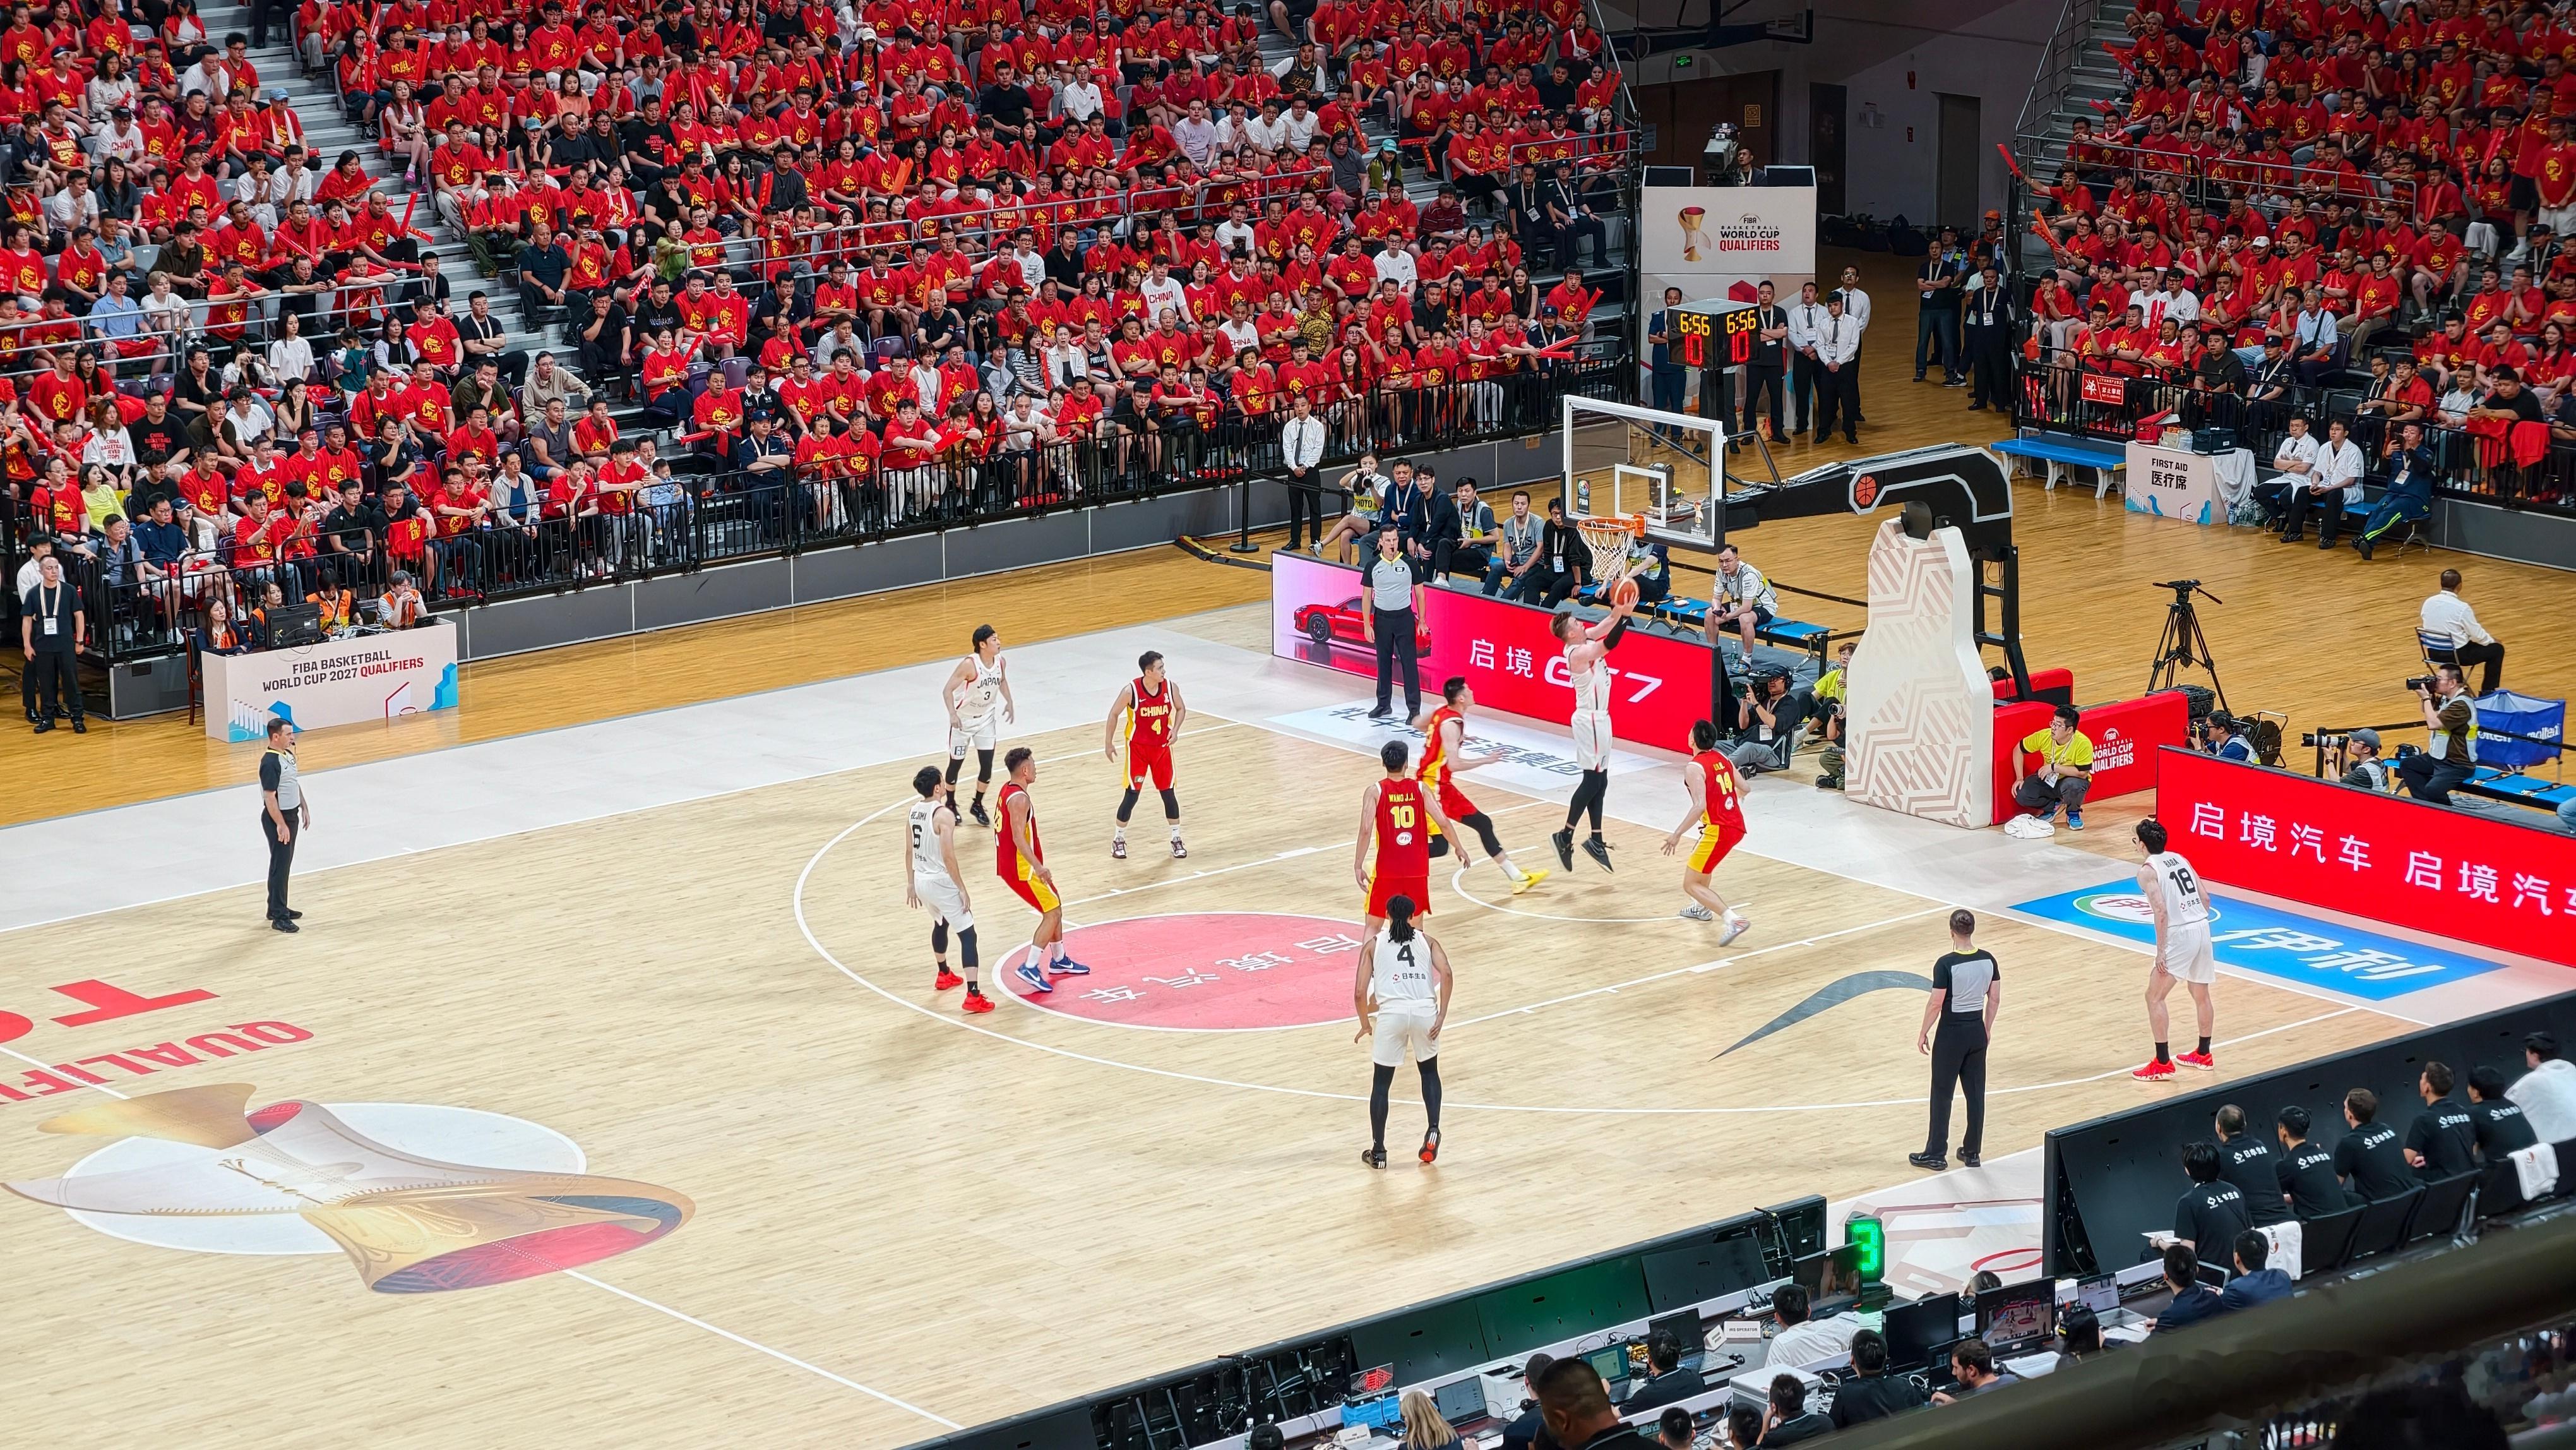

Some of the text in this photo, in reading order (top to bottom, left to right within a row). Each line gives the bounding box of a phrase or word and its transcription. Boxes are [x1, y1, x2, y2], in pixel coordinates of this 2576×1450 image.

[51, 140, 75, 150] CHINA
[112, 139, 134, 151] CHINA
[994, 211, 1016, 219] CHINA
[1720, 231, 1780, 239] WORLD CUP
[1719, 239, 1780, 252] QUALIFIERS
[1148, 291, 1174, 304] CHINA
[1680, 313, 1710, 336] 6:56
[1727, 309, 1756, 334] 6:56
[1230, 337, 1251, 347] CHINA
[1732, 331, 1749, 362] 10
[1685, 333, 1703, 366] 10
[2152, 458, 2188, 471] FIRST AID
[2151, 470, 2187, 490] 医疗席
[1354, 498, 1373, 508] PHOTO
[1578, 498, 1589, 506] FIBA
[292, 650, 392, 674] FIBA BASKETBALL
[1469, 638, 1534, 679] 启境
[263, 657, 424, 692] WORLD CUP 2027 QUALIFIERS
[977, 677, 1001, 688] JAPAN
[984, 692, 991, 700] 3
[1140, 704, 1169, 717] CHINA
[1151, 719, 1162, 735] 4
[2527, 723, 2561, 740] molten
[2094, 738, 2133, 750] ASKETBALL
[2106, 733, 2116, 741] FIBA
[2118, 743, 2133, 753] CUP
[1715, 771, 1733, 795] 14
[1389, 794, 1404, 803] WANG
[1390, 805, 1415, 829] 10
[2190, 801, 2372, 872] 启境汽车
[2163, 858, 2179, 868] BABA
[2169, 868, 2196, 896] 18
[1397, 944, 1415, 968] 4
[2211, 927, 2447, 980] 伊利
[0, 1021, 314, 1106] QUALIFI
[1851, 1223, 1878, 1271] 3
